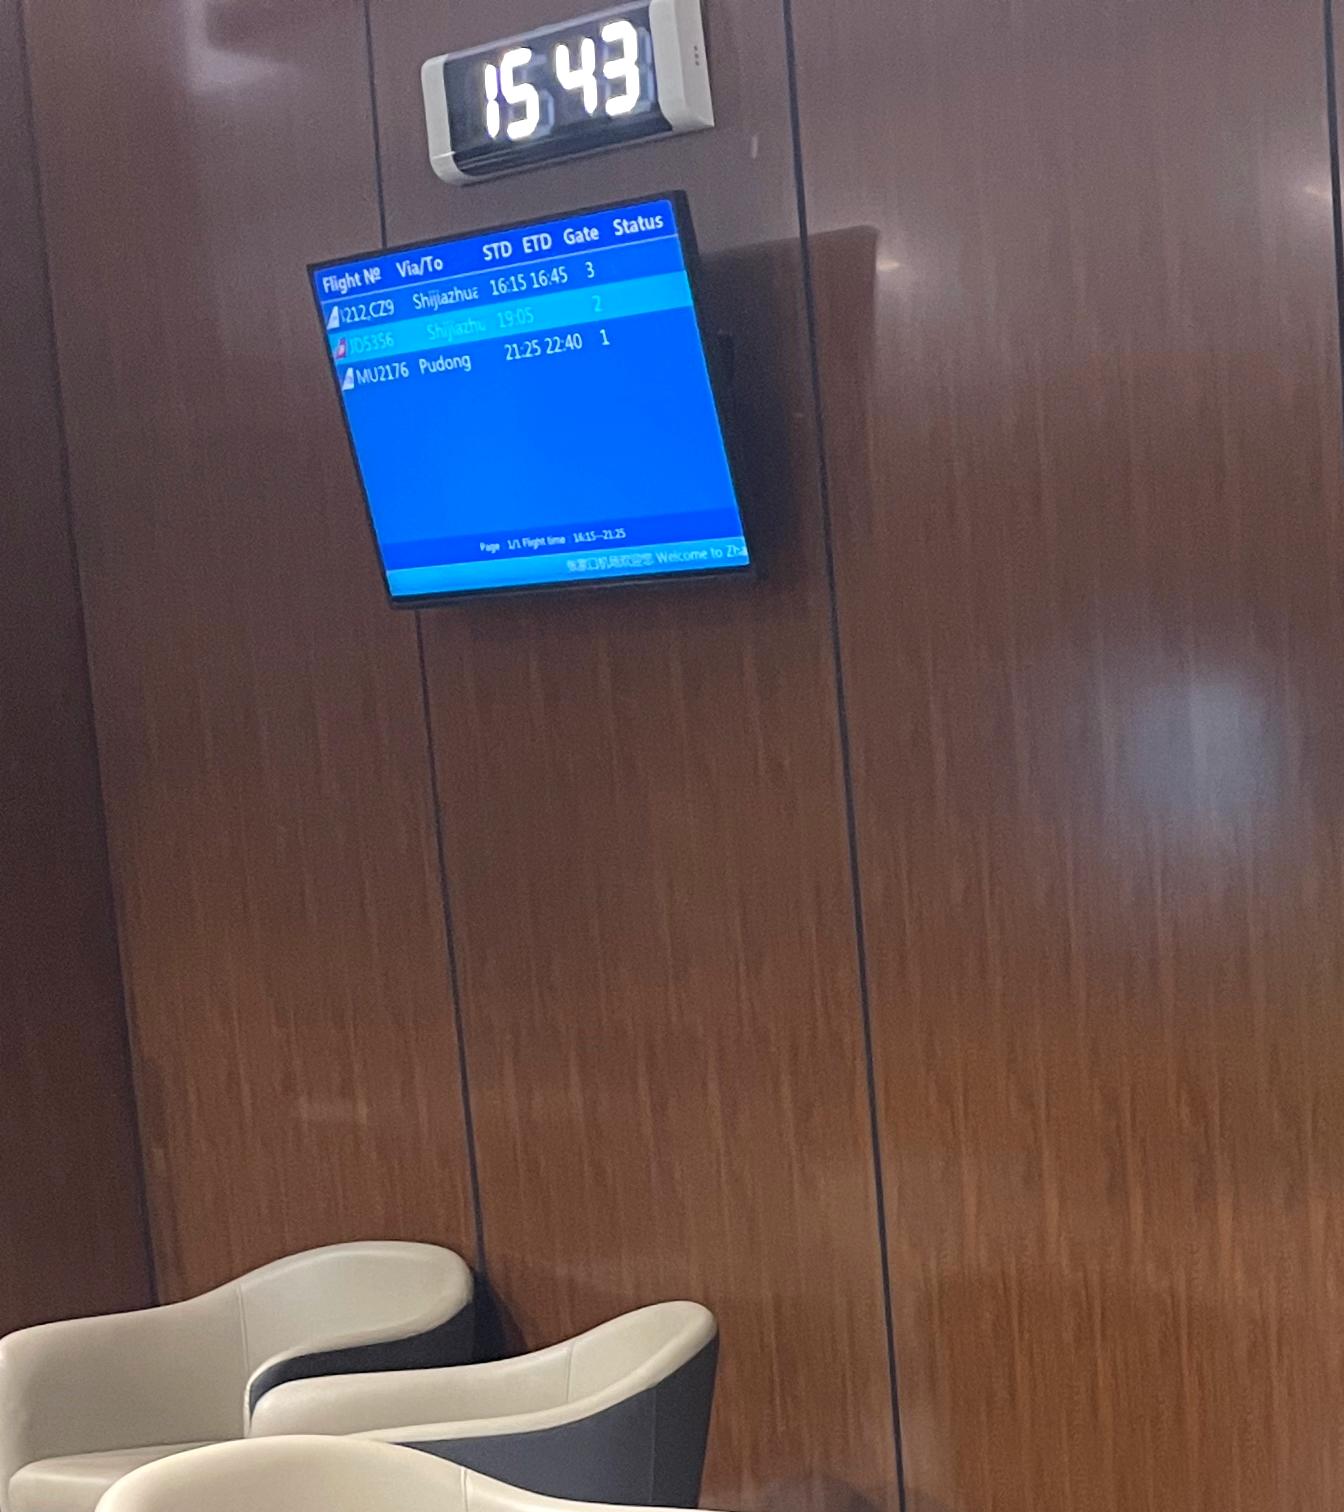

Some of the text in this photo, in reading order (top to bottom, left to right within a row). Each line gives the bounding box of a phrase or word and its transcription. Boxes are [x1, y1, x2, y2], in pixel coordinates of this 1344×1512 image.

[484, 20, 641, 140] 15 43
[322, 273, 362, 295] Flight
[396, 256, 444, 278] Via/To
[482, 241, 512, 261] STD
[522, 233, 552, 253] ETD
[563, 226, 600, 245] Gate
[613, 215, 664, 236] Status
[489, 273, 527, 295] 16:15
[530, 266, 568, 289] 16:45
[585, 261, 595, 279] 3
[498, 307, 534, 328] 19:05
[592, 295, 603, 312] 2
[356, 328, 610, 384] MU2176 Pudong 21:25 22:40 1
[480, 542, 500, 553] Page
[522, 537, 546, 550] Flight
[547, 535, 565, 546] time
[656, 548, 708, 565] Welcome
[711, 548, 722, 559] to
